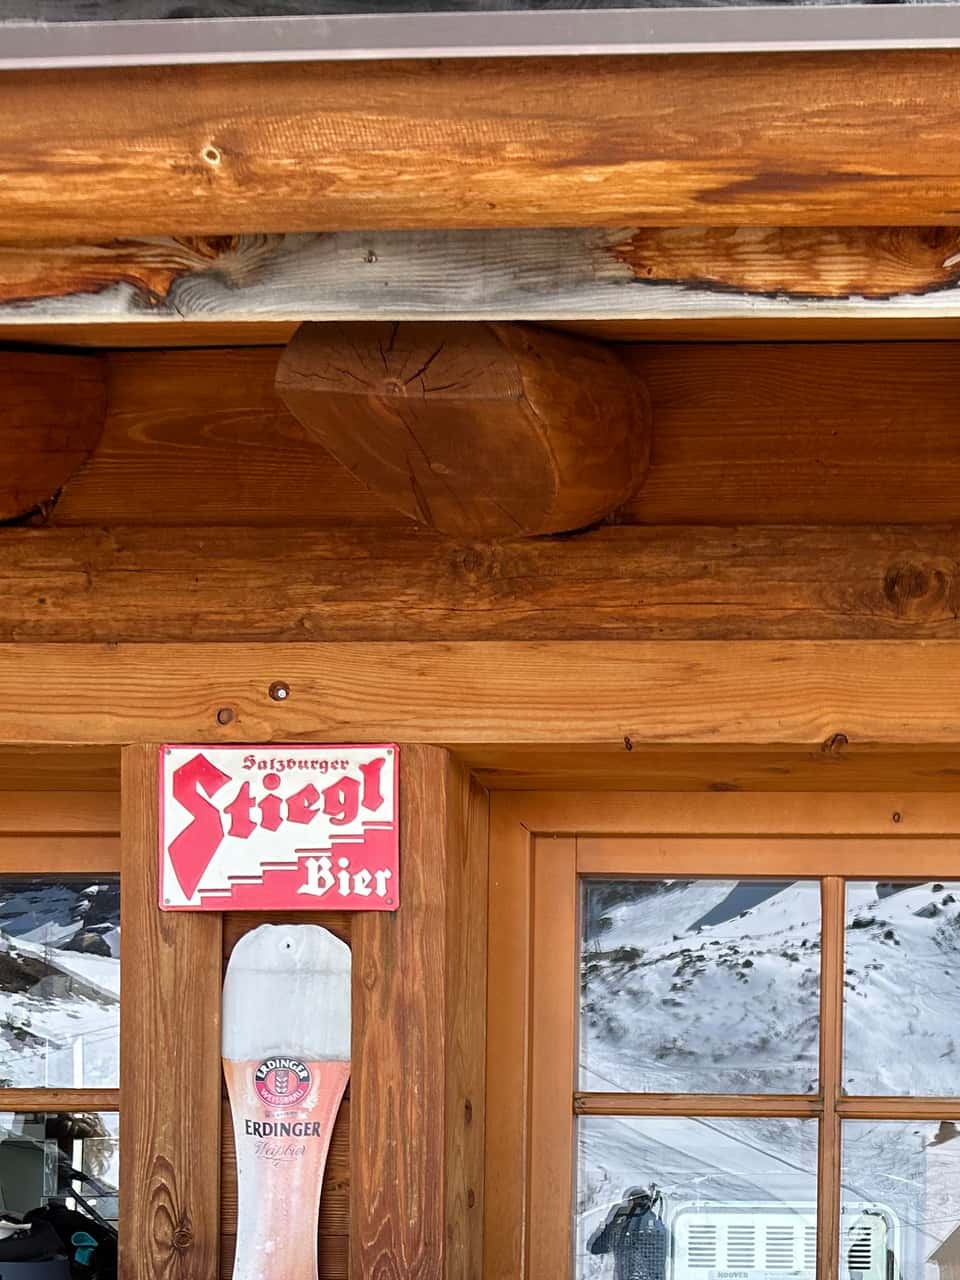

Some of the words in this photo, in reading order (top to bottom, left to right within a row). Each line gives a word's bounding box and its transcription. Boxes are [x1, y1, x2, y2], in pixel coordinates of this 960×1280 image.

[242, 754, 349, 773] Salzburger
[168, 753, 386, 900] Stiegl
[297, 856, 391, 897] Bier
[256, 1058, 309, 1079] ERDINGER
[244, 1119, 321, 1138] ERDINGER
